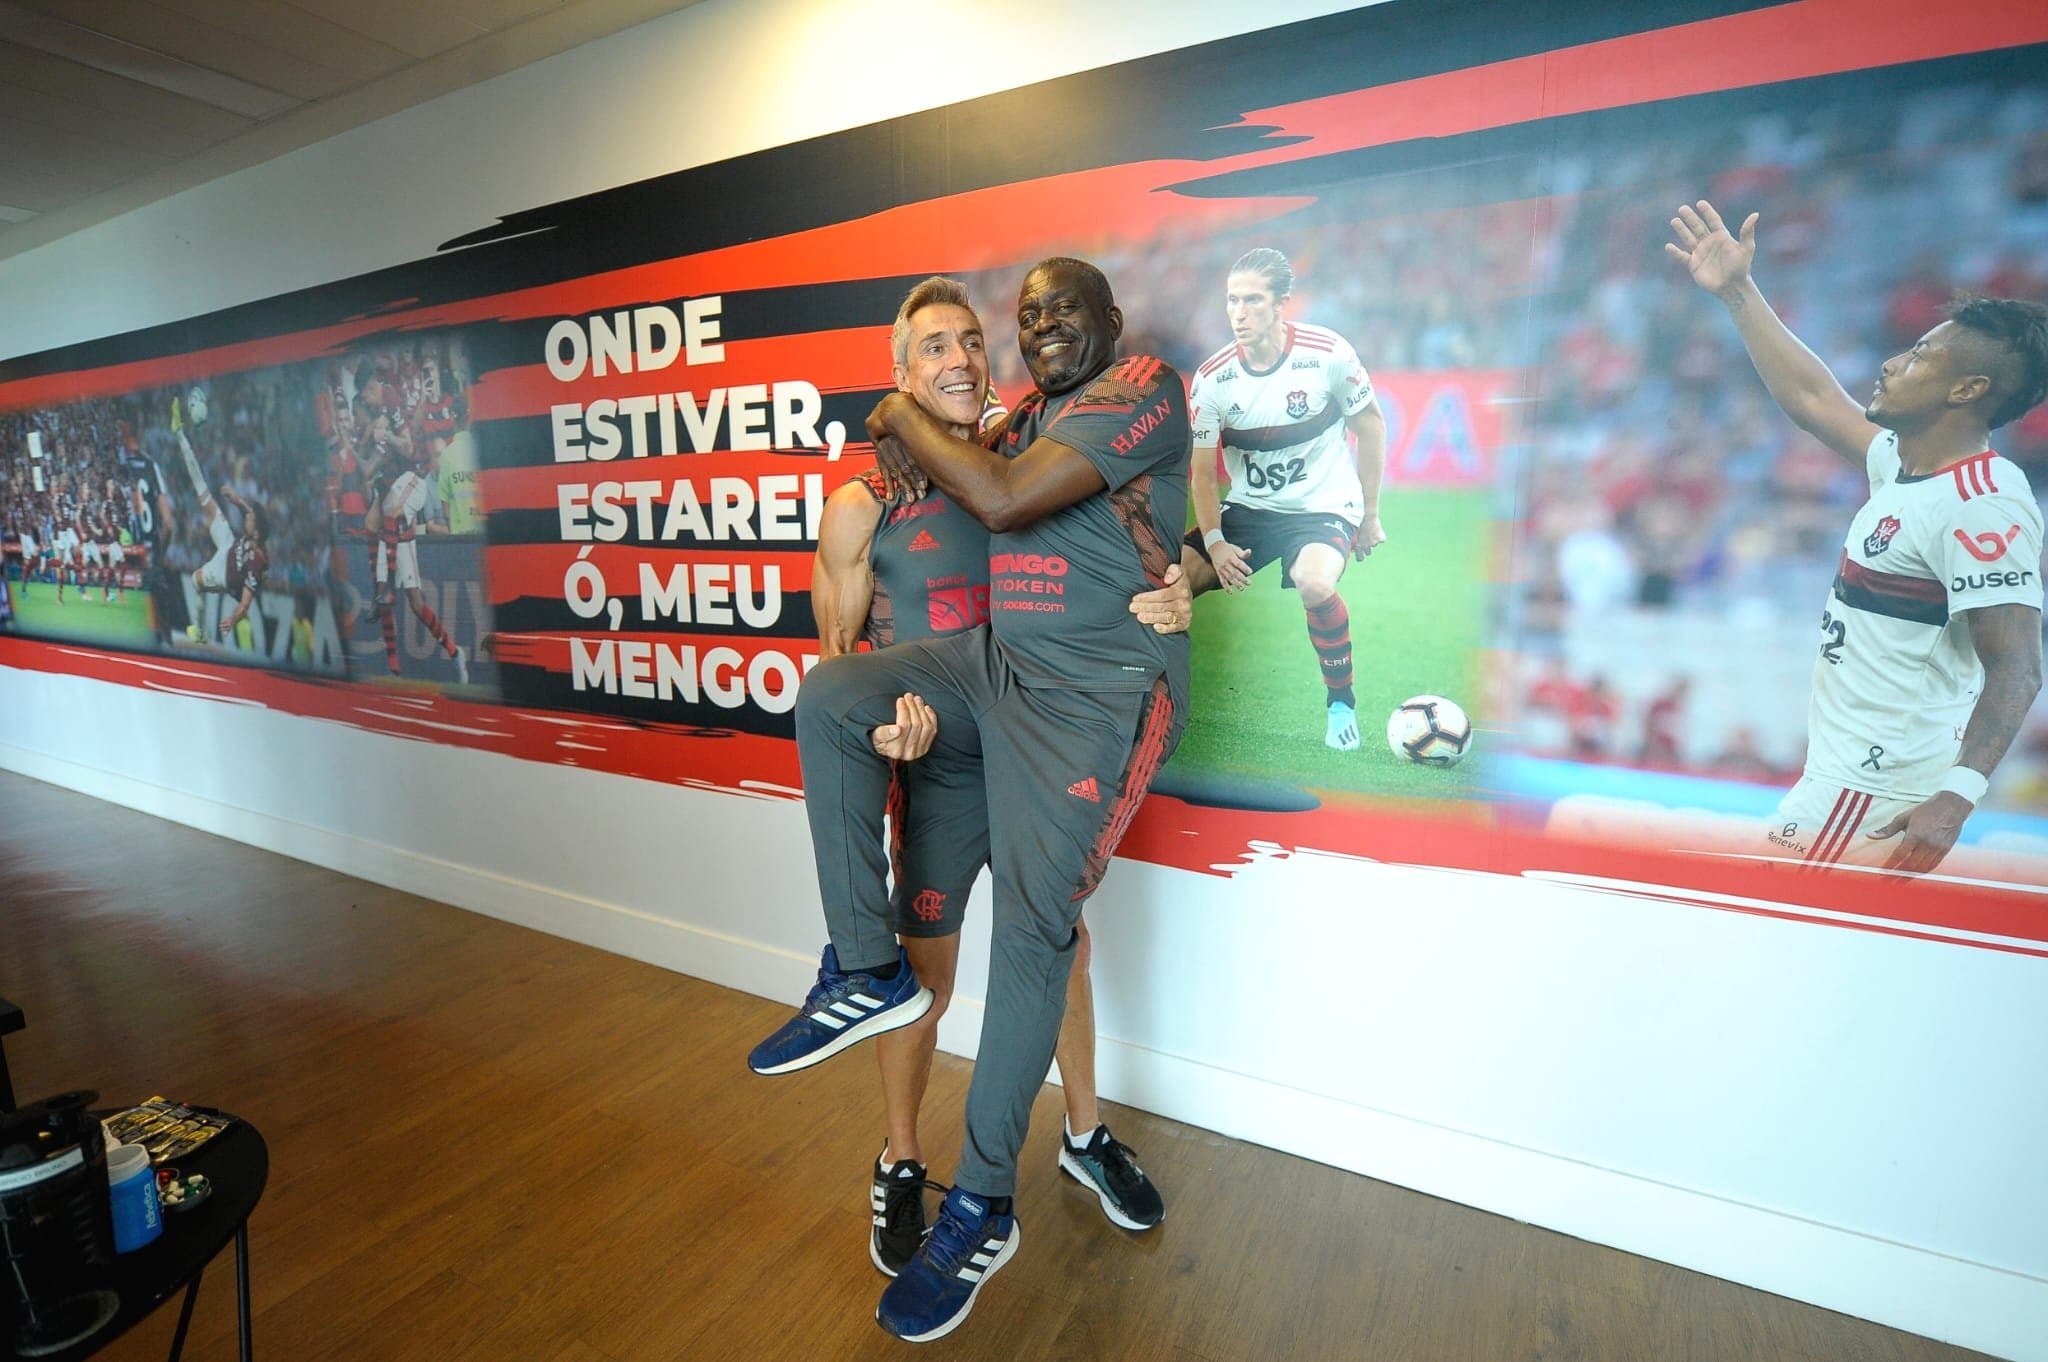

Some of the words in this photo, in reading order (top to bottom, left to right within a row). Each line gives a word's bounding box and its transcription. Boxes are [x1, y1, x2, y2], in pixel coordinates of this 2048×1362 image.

[545, 296, 725, 382] ONDE
[551, 380, 847, 462] ESTIVER,
[1110, 399, 1173, 455] HAVAN
[557, 474, 823, 541] ESTAREI
[564, 545, 623, 631] Ó,
[639, 563, 782, 628] MEU
[997, 578, 1064, 595] TOKEN
[1951, 571, 2033, 593] buser
